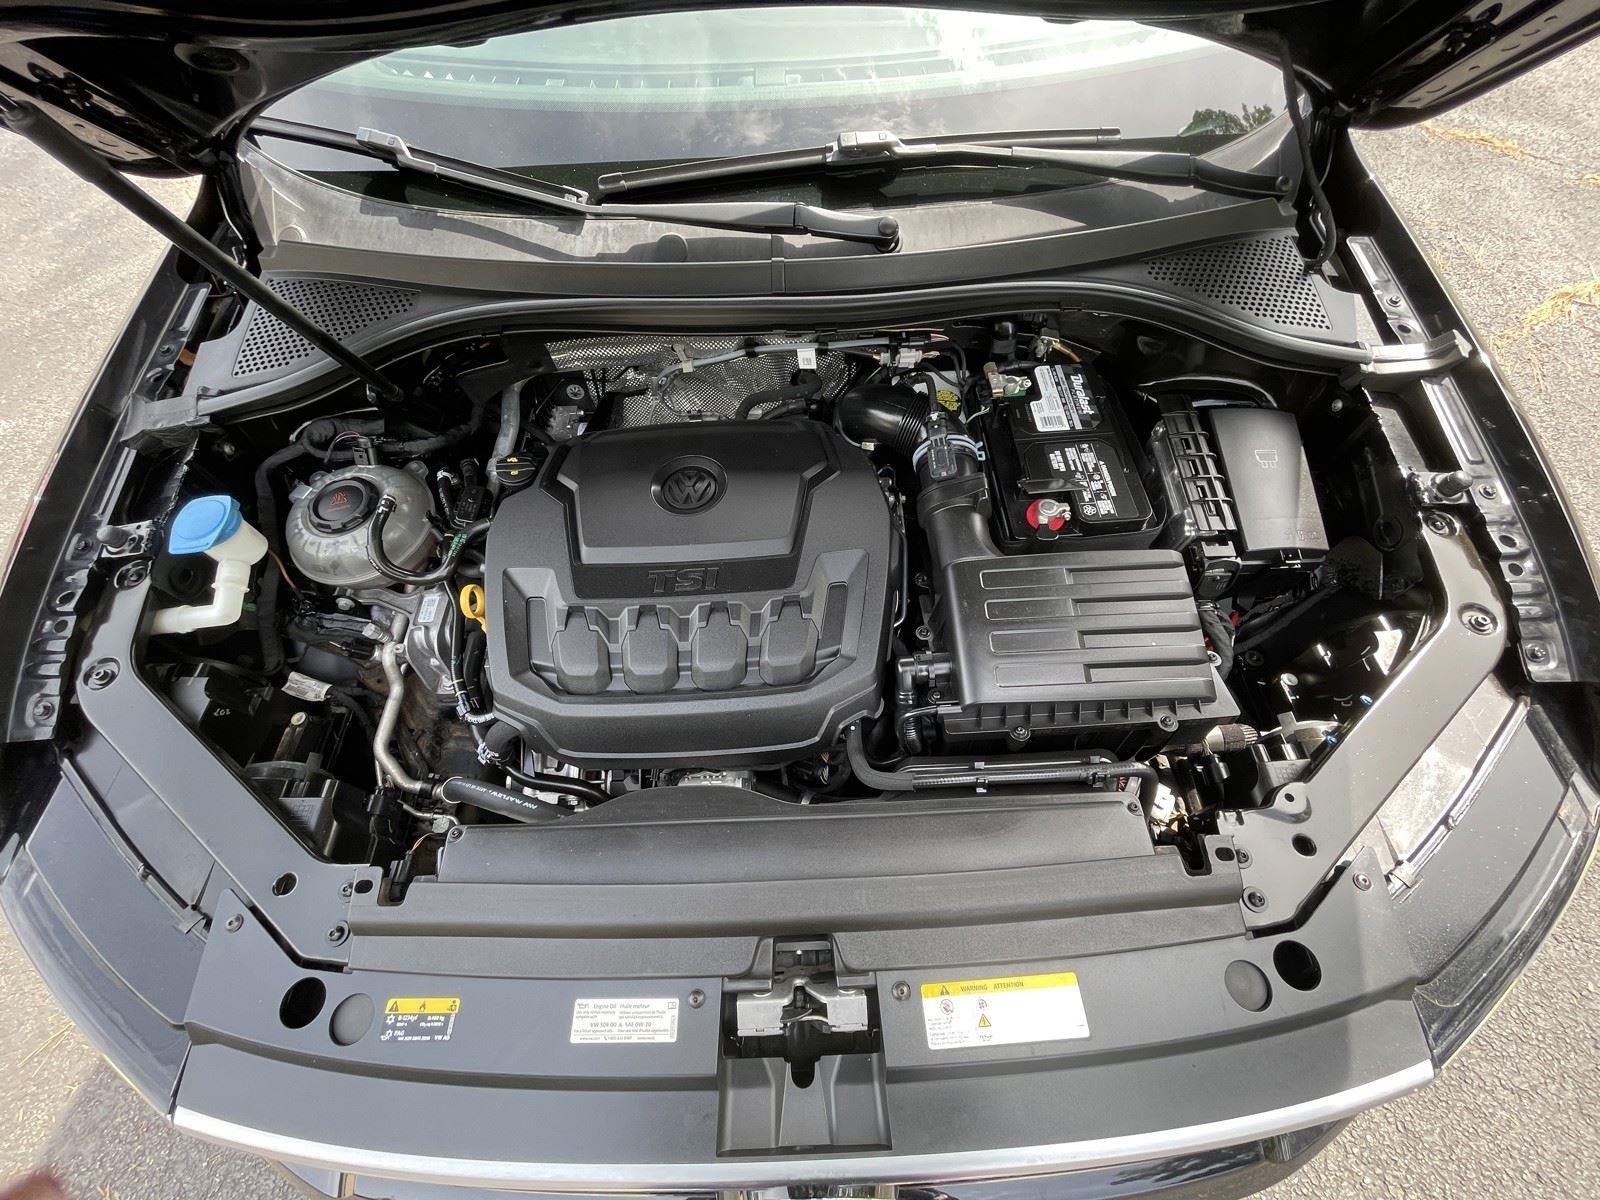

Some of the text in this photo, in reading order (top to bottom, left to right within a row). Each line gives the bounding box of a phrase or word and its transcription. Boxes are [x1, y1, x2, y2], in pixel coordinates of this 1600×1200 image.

[1069, 372, 1095, 414] Duralast
[648, 567, 719, 593] TSI
[960, 981, 1024, 992] WARNING ATTENTION
